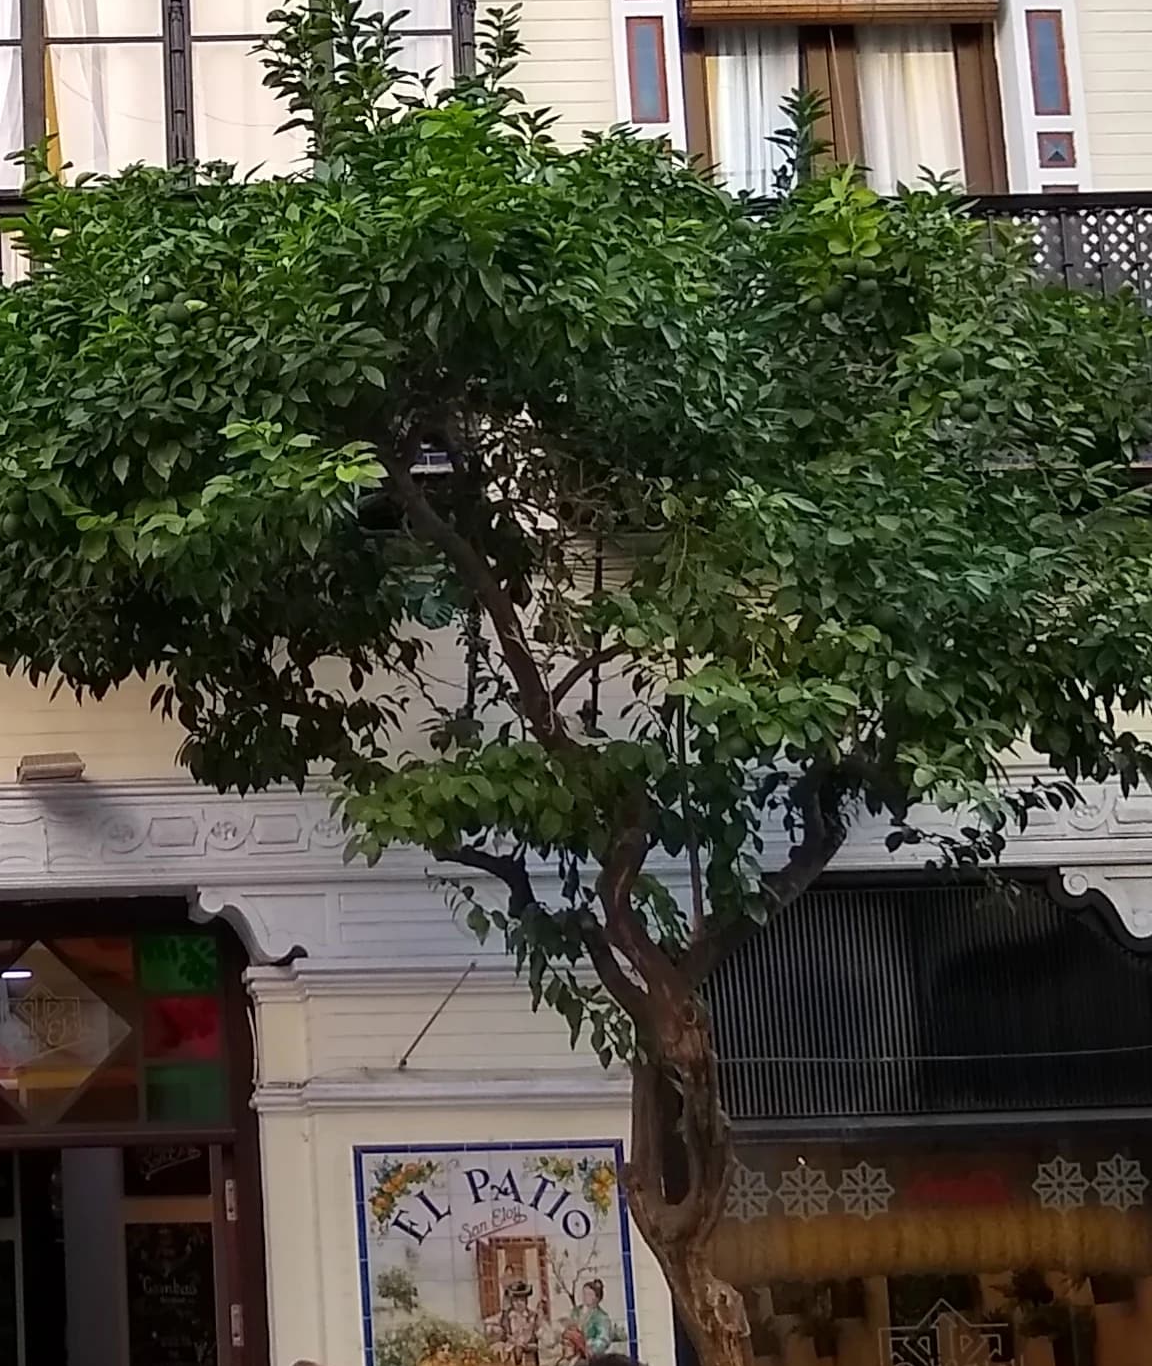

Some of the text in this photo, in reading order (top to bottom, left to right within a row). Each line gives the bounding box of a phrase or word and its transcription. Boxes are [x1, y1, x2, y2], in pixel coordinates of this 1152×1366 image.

[392, 1168, 593, 1246] EL PATIO
[458, 1206, 528, 1245] San Eloy
